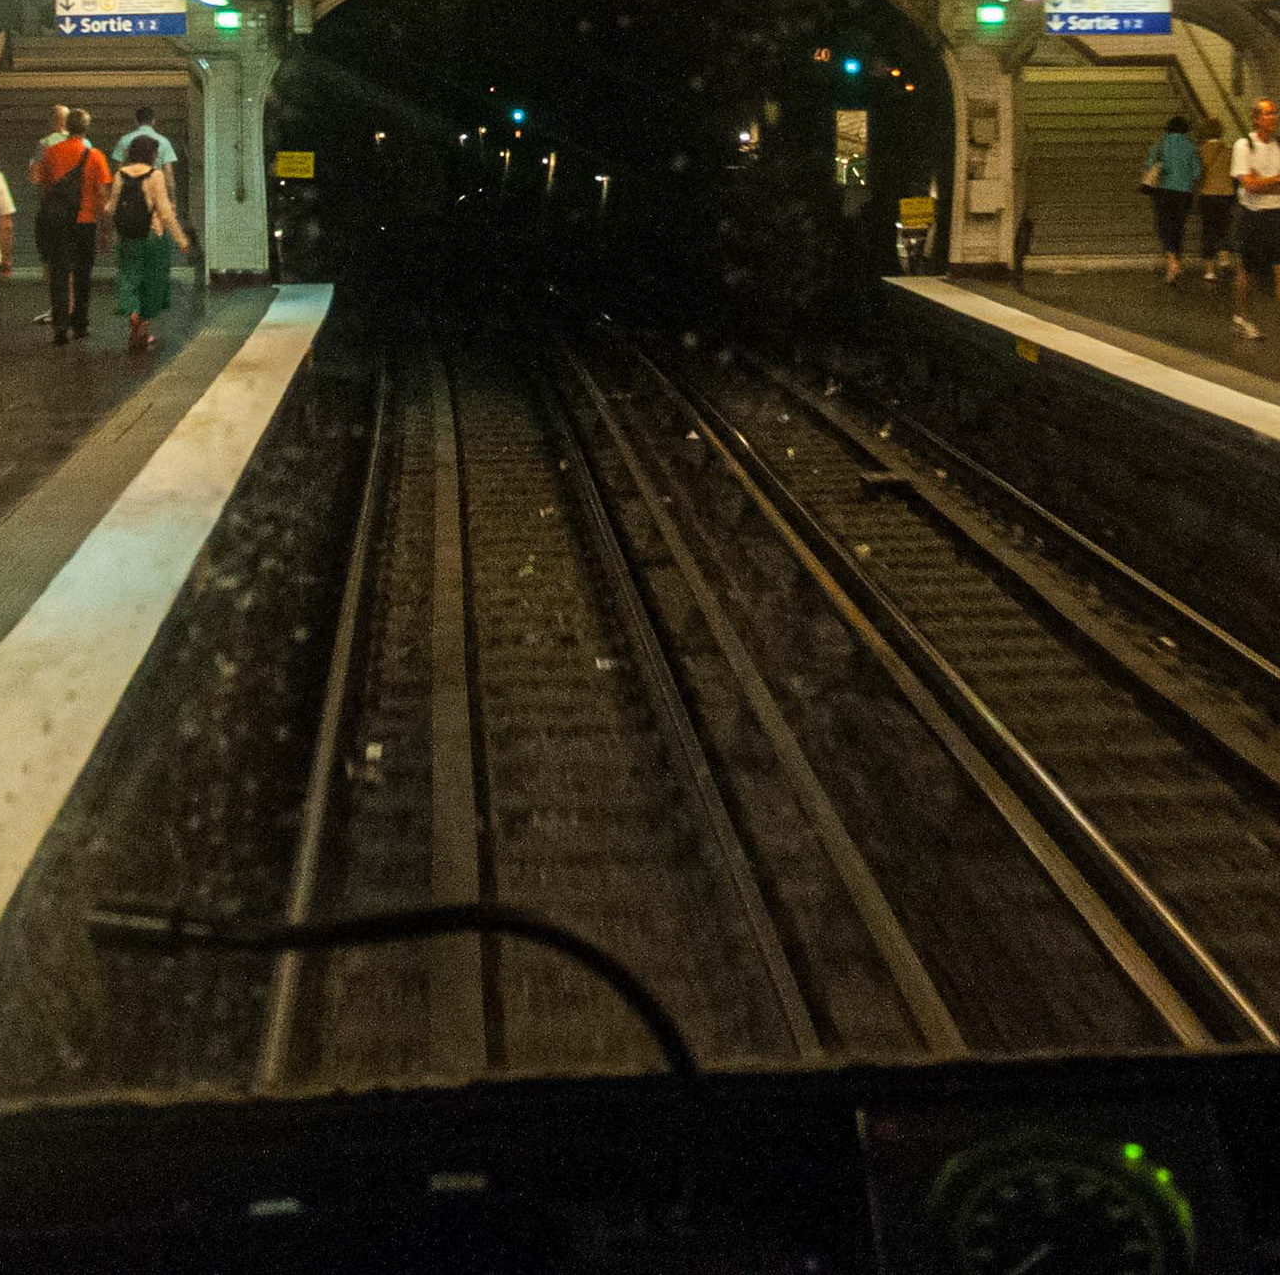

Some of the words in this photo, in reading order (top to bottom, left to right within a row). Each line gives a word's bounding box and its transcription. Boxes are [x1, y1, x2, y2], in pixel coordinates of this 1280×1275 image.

[80, 16, 133, 33] Sortie
[138, 20, 145, 30] 1
[150, 20, 157, 30] 2
[1067, 15, 1120, 31] Sortie
